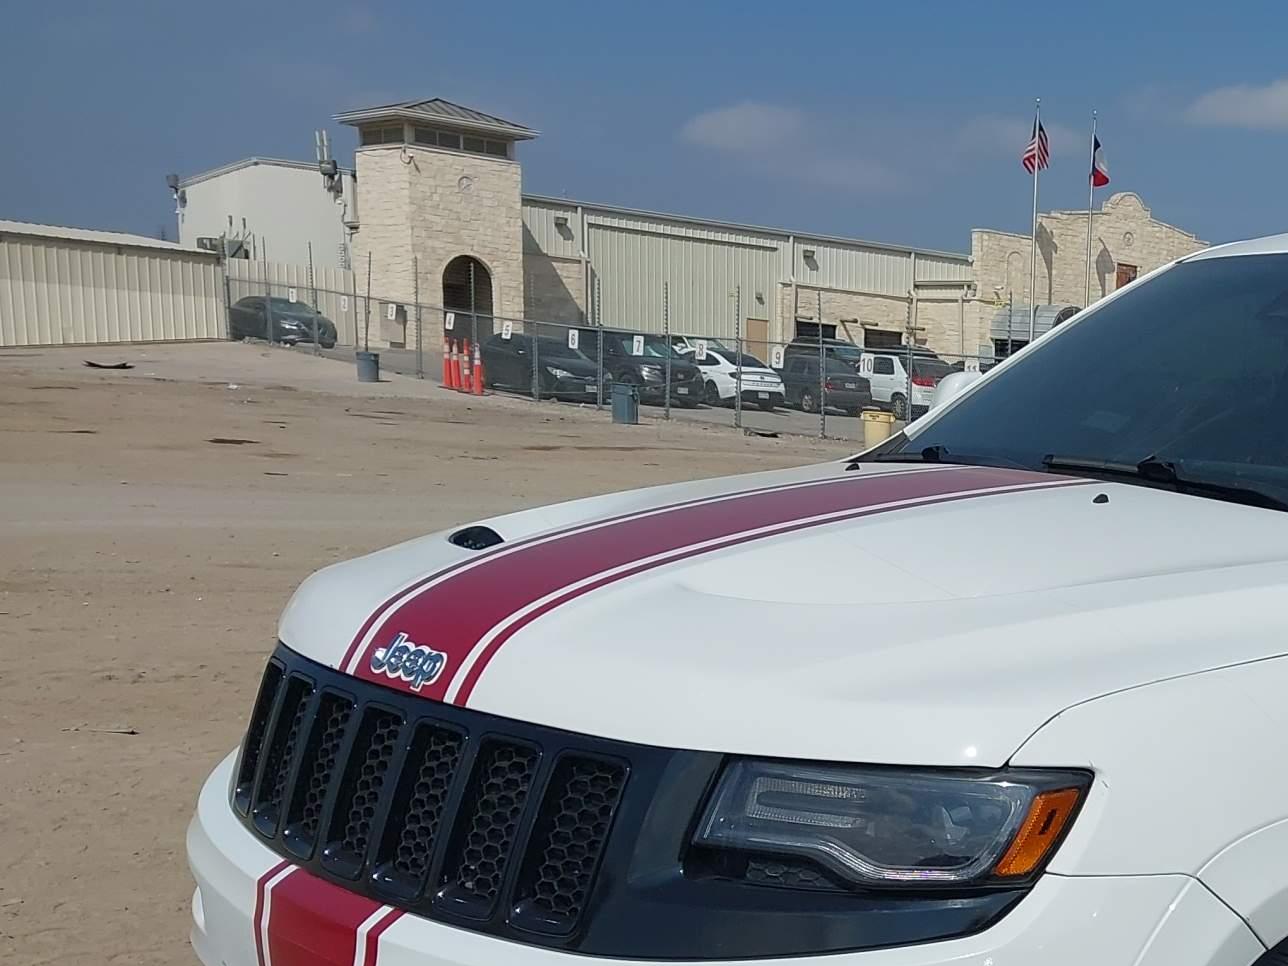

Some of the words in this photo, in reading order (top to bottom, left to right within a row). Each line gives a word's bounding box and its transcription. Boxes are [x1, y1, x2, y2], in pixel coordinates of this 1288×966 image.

[503, 325, 510, 336] 5
[570, 333, 576, 346] 6
[635, 340, 642, 353] 7
[775, 351, 781, 365] 9
[861, 357, 873, 373] 10
[370, 632, 447, 691] Jeep
